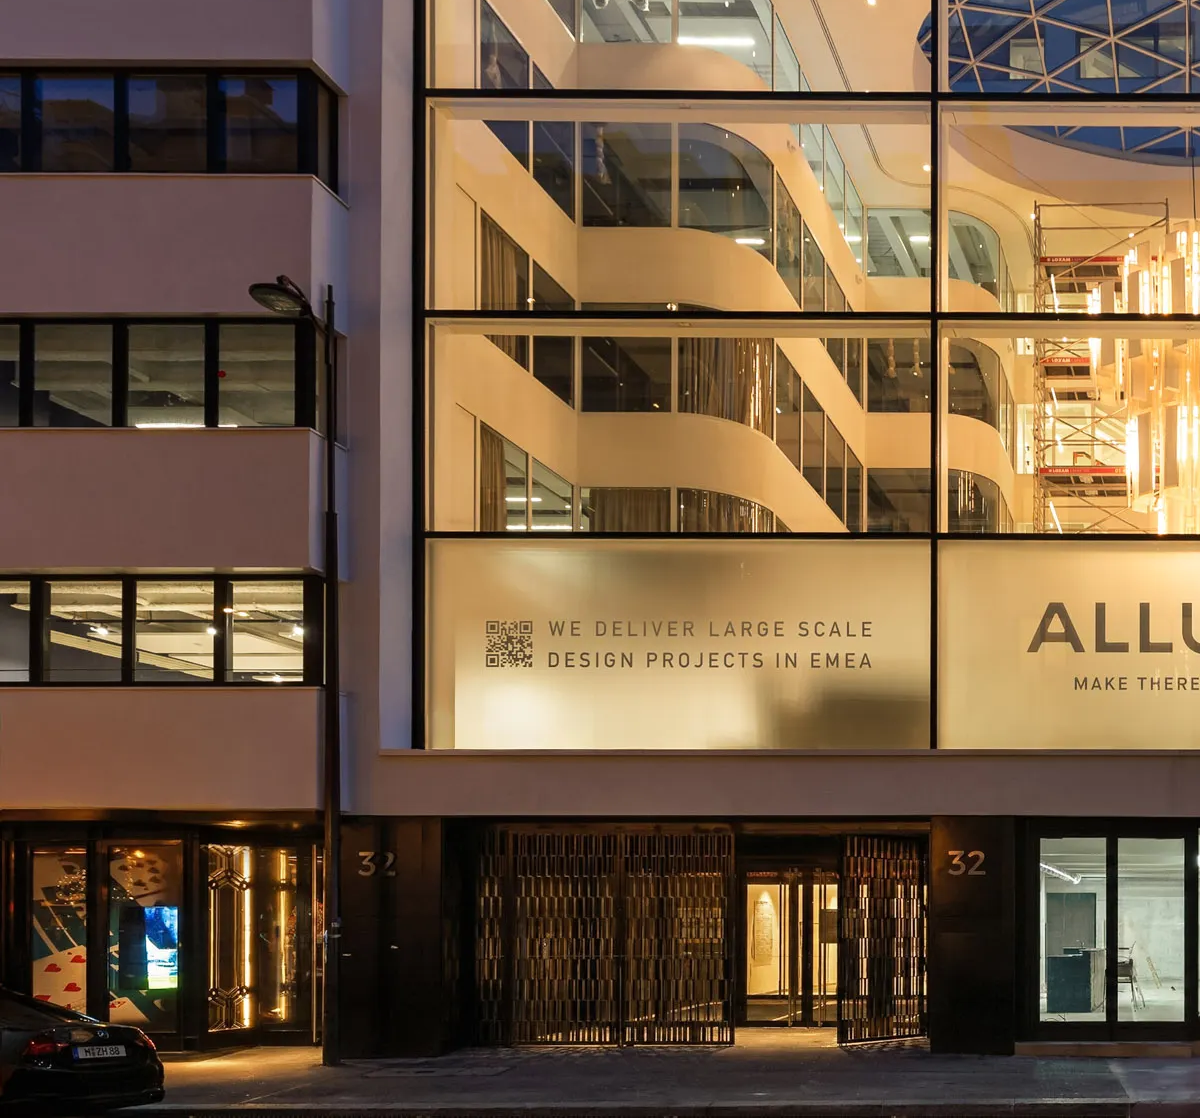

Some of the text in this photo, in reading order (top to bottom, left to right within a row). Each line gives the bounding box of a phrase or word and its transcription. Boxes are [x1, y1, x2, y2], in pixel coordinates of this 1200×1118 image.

[548, 621, 873, 638] WE DELIVER LARGE SCALE
[548, 652, 872, 669] DESIGN PROJECTS IN EMEA
[1074, 677, 1128, 691] MAKE
[358, 851, 396, 876] 32
[948, 850, 986, 876] 32
